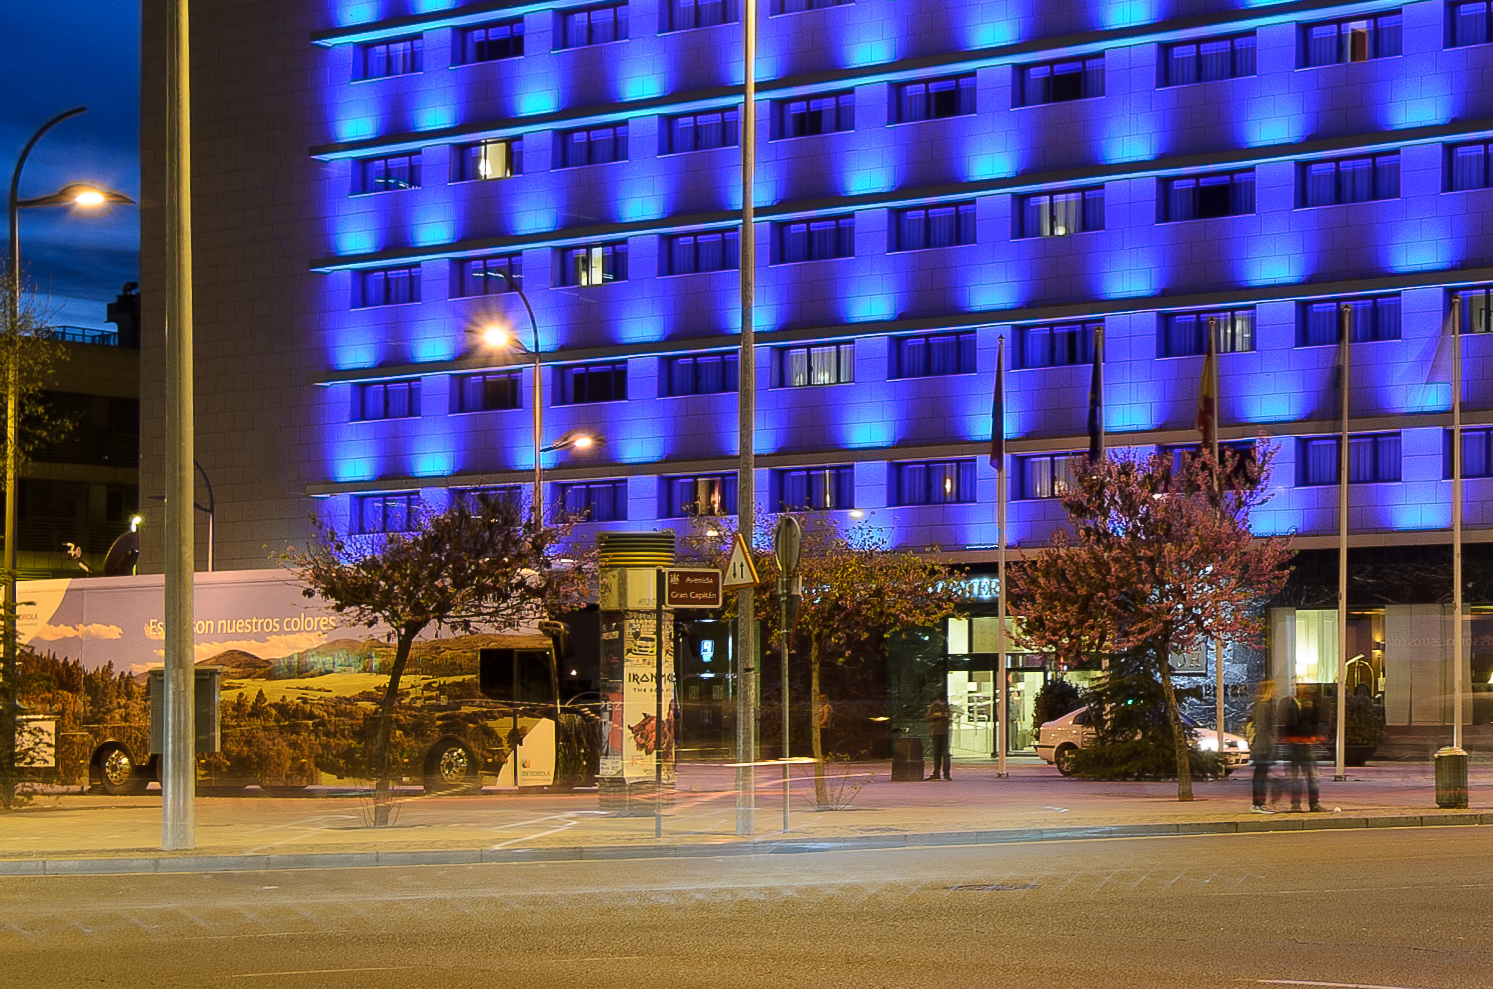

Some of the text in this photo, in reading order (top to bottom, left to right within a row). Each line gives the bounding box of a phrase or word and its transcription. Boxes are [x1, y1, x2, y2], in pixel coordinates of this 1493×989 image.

[685, 576, 713, 584] Avenida
[670, 591, 688, 599] Gran
[193, 613, 336, 635] son nuestros colores
